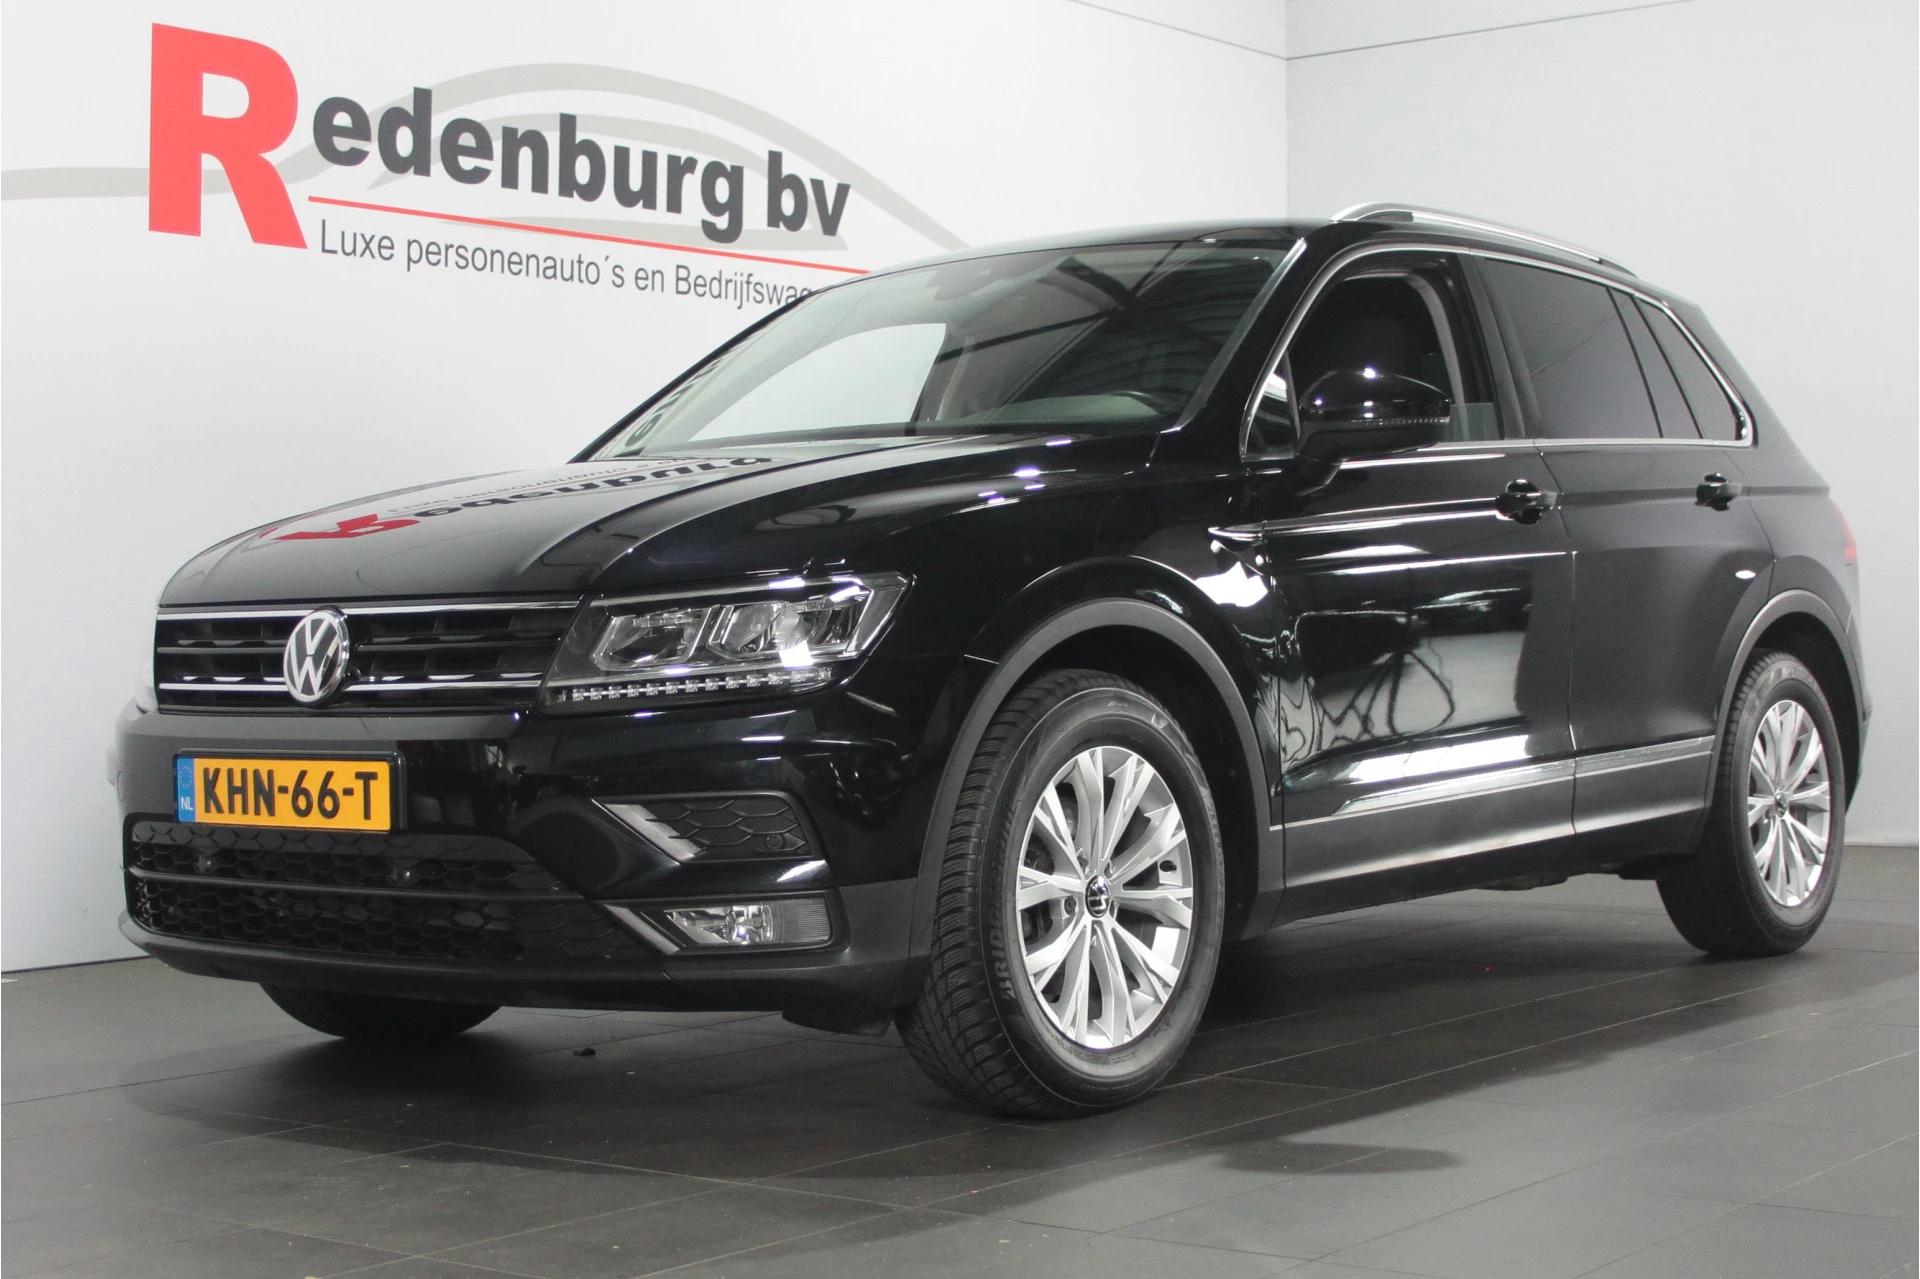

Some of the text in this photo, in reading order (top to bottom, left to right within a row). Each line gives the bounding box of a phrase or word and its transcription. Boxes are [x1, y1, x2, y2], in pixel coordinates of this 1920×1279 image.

[148, 22, 852, 249] Redenburg bv
[320, 218, 395, 261] Luxe
[634, 267, 665, 293] en
[180, 796, 194, 811] NL
[202, 767, 379, 821] KHN-66-T
